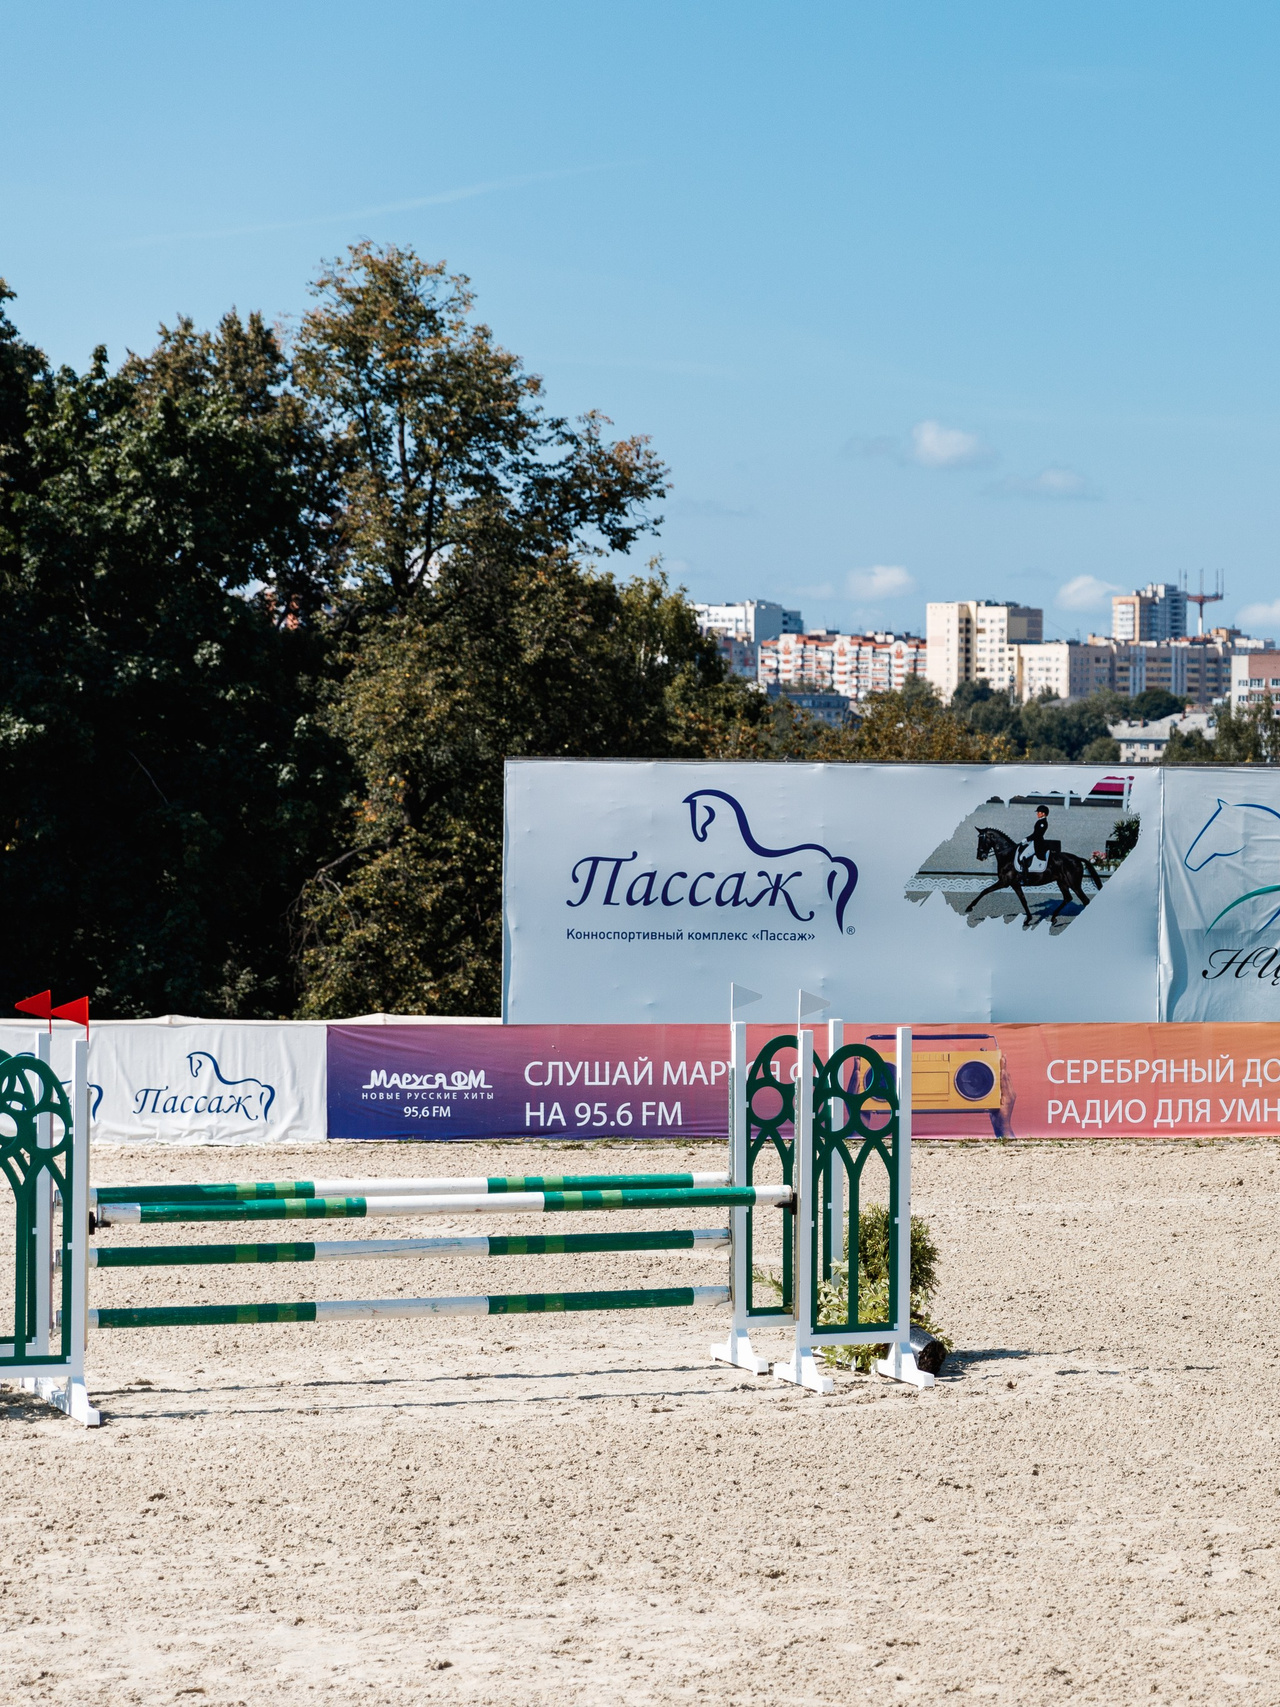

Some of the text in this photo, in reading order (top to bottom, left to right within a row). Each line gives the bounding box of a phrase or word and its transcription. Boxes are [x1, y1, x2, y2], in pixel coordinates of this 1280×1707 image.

[566, 850, 815, 922] Пассаж
[566, 928, 815, 943] Конноспортивный комплекс «Пассаж»
[524, 1056, 652, 1087] СЛУШАЙ
[1046, 1054, 1235, 1084] СЕРЕБРЯНЫЙ
[132, 1085, 258, 1121] Пассаж
[361, 1092, 494, 1100] НОВЫЕ РУССКИЕ ХИТЫ
[403, 1105, 451, 1119] 95,6 FM
[525, 1101, 683, 1127] НА 95.6 FM
[1047, 1099, 1147, 1129] РАДИО
[1153, 1098, 1211, 1128] ДЛЯ
